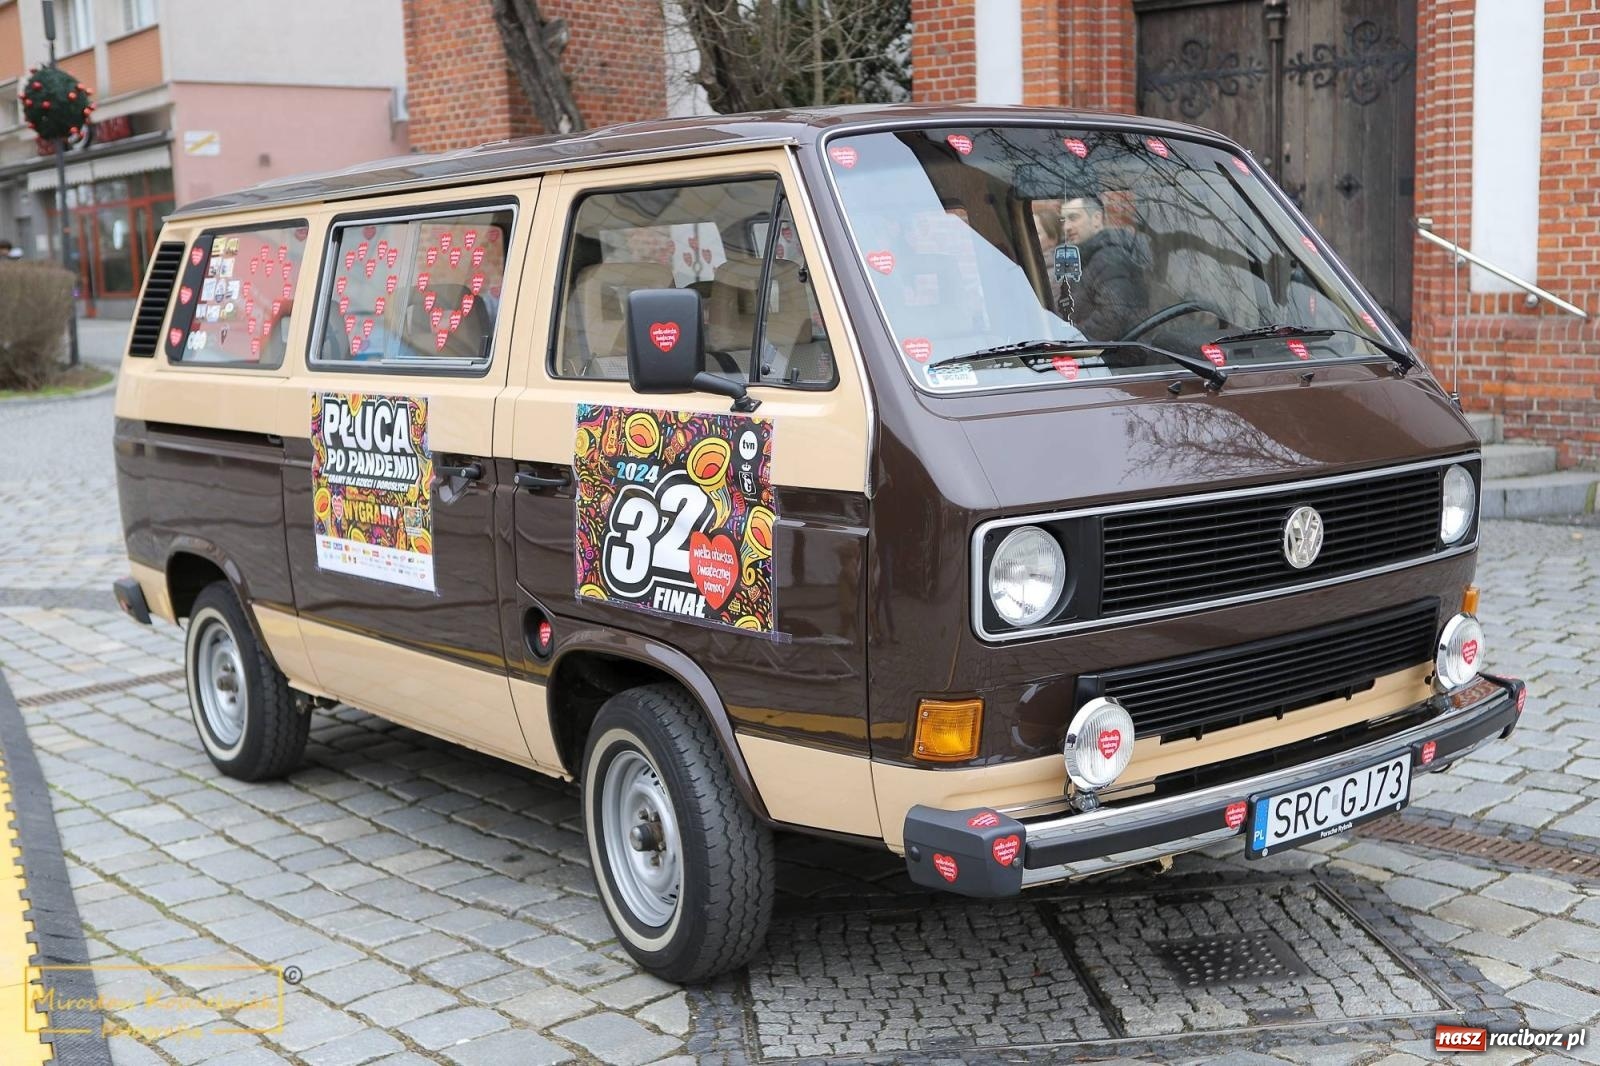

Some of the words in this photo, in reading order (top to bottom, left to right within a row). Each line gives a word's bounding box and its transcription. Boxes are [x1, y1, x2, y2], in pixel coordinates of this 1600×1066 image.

[324, 402, 414, 454] PŁUCA
[742, 439, 755, 450] tvn
[327, 449, 346, 472] PO
[349, 450, 417, 481] PANDEMII
[616, 461, 659, 484] 2024
[343, 500, 398, 527] WYGRAMY
[610, 483, 708, 584] 32
[653, 586, 707, 619] FINAŁ
[1274, 786, 1331, 838] SRC
[1340, 761, 1404, 818] GJ73
[1254, 829, 1265, 842] PL
